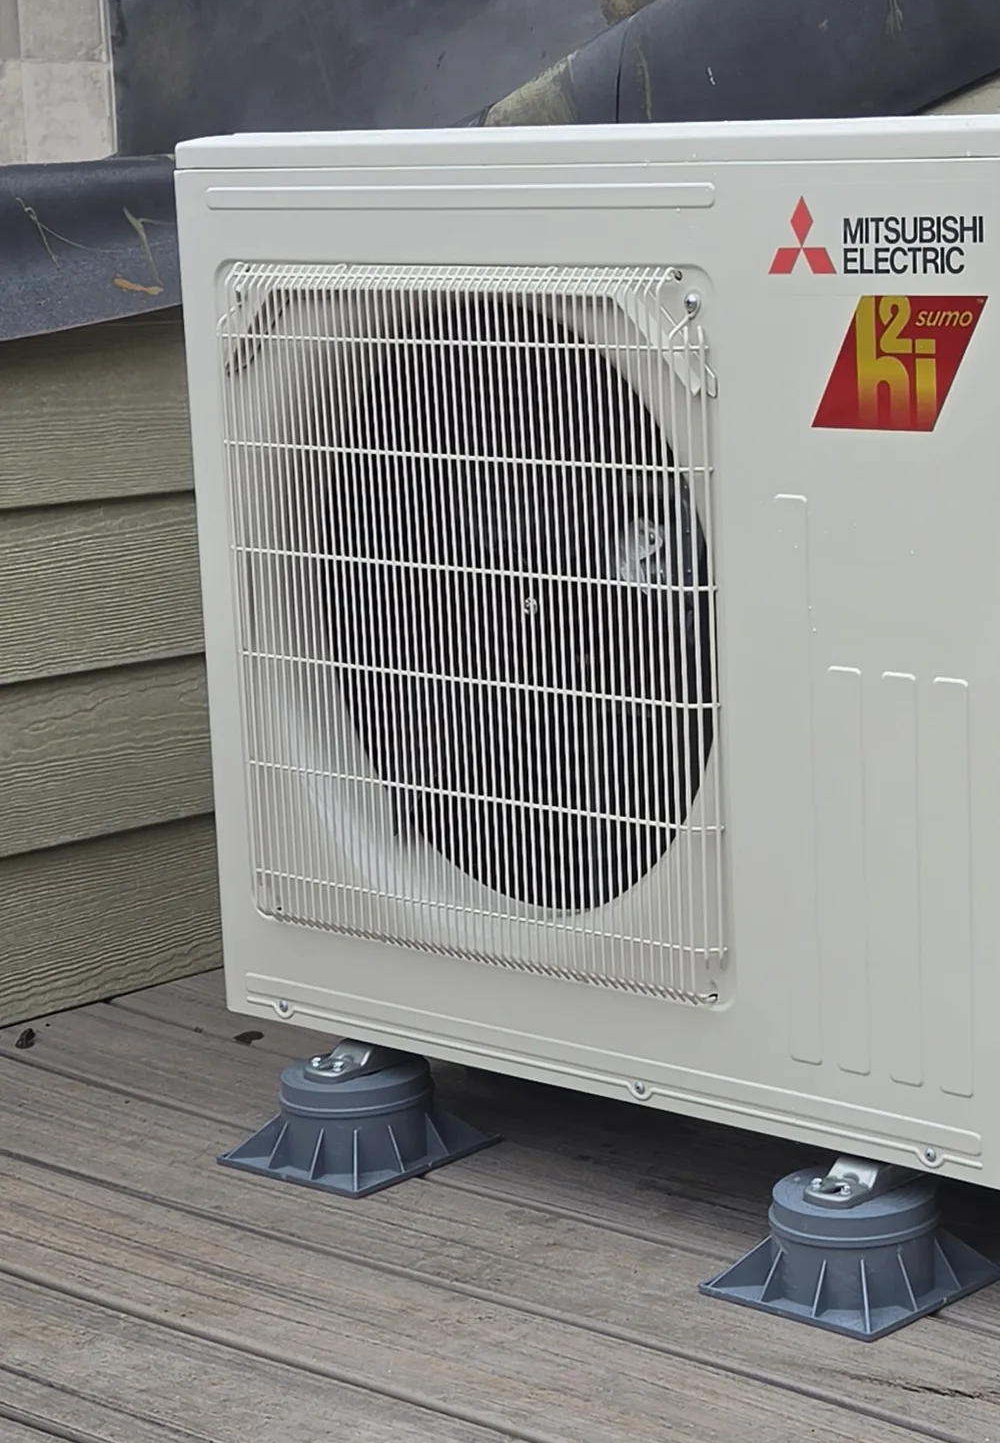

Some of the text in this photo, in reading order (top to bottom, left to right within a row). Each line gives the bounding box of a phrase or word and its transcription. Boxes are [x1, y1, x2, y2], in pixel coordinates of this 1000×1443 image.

[843, 216, 984, 244] MITSUBISHI
[843, 247, 965, 274] ELECTRIC
[915, 310, 973, 327] sumo
